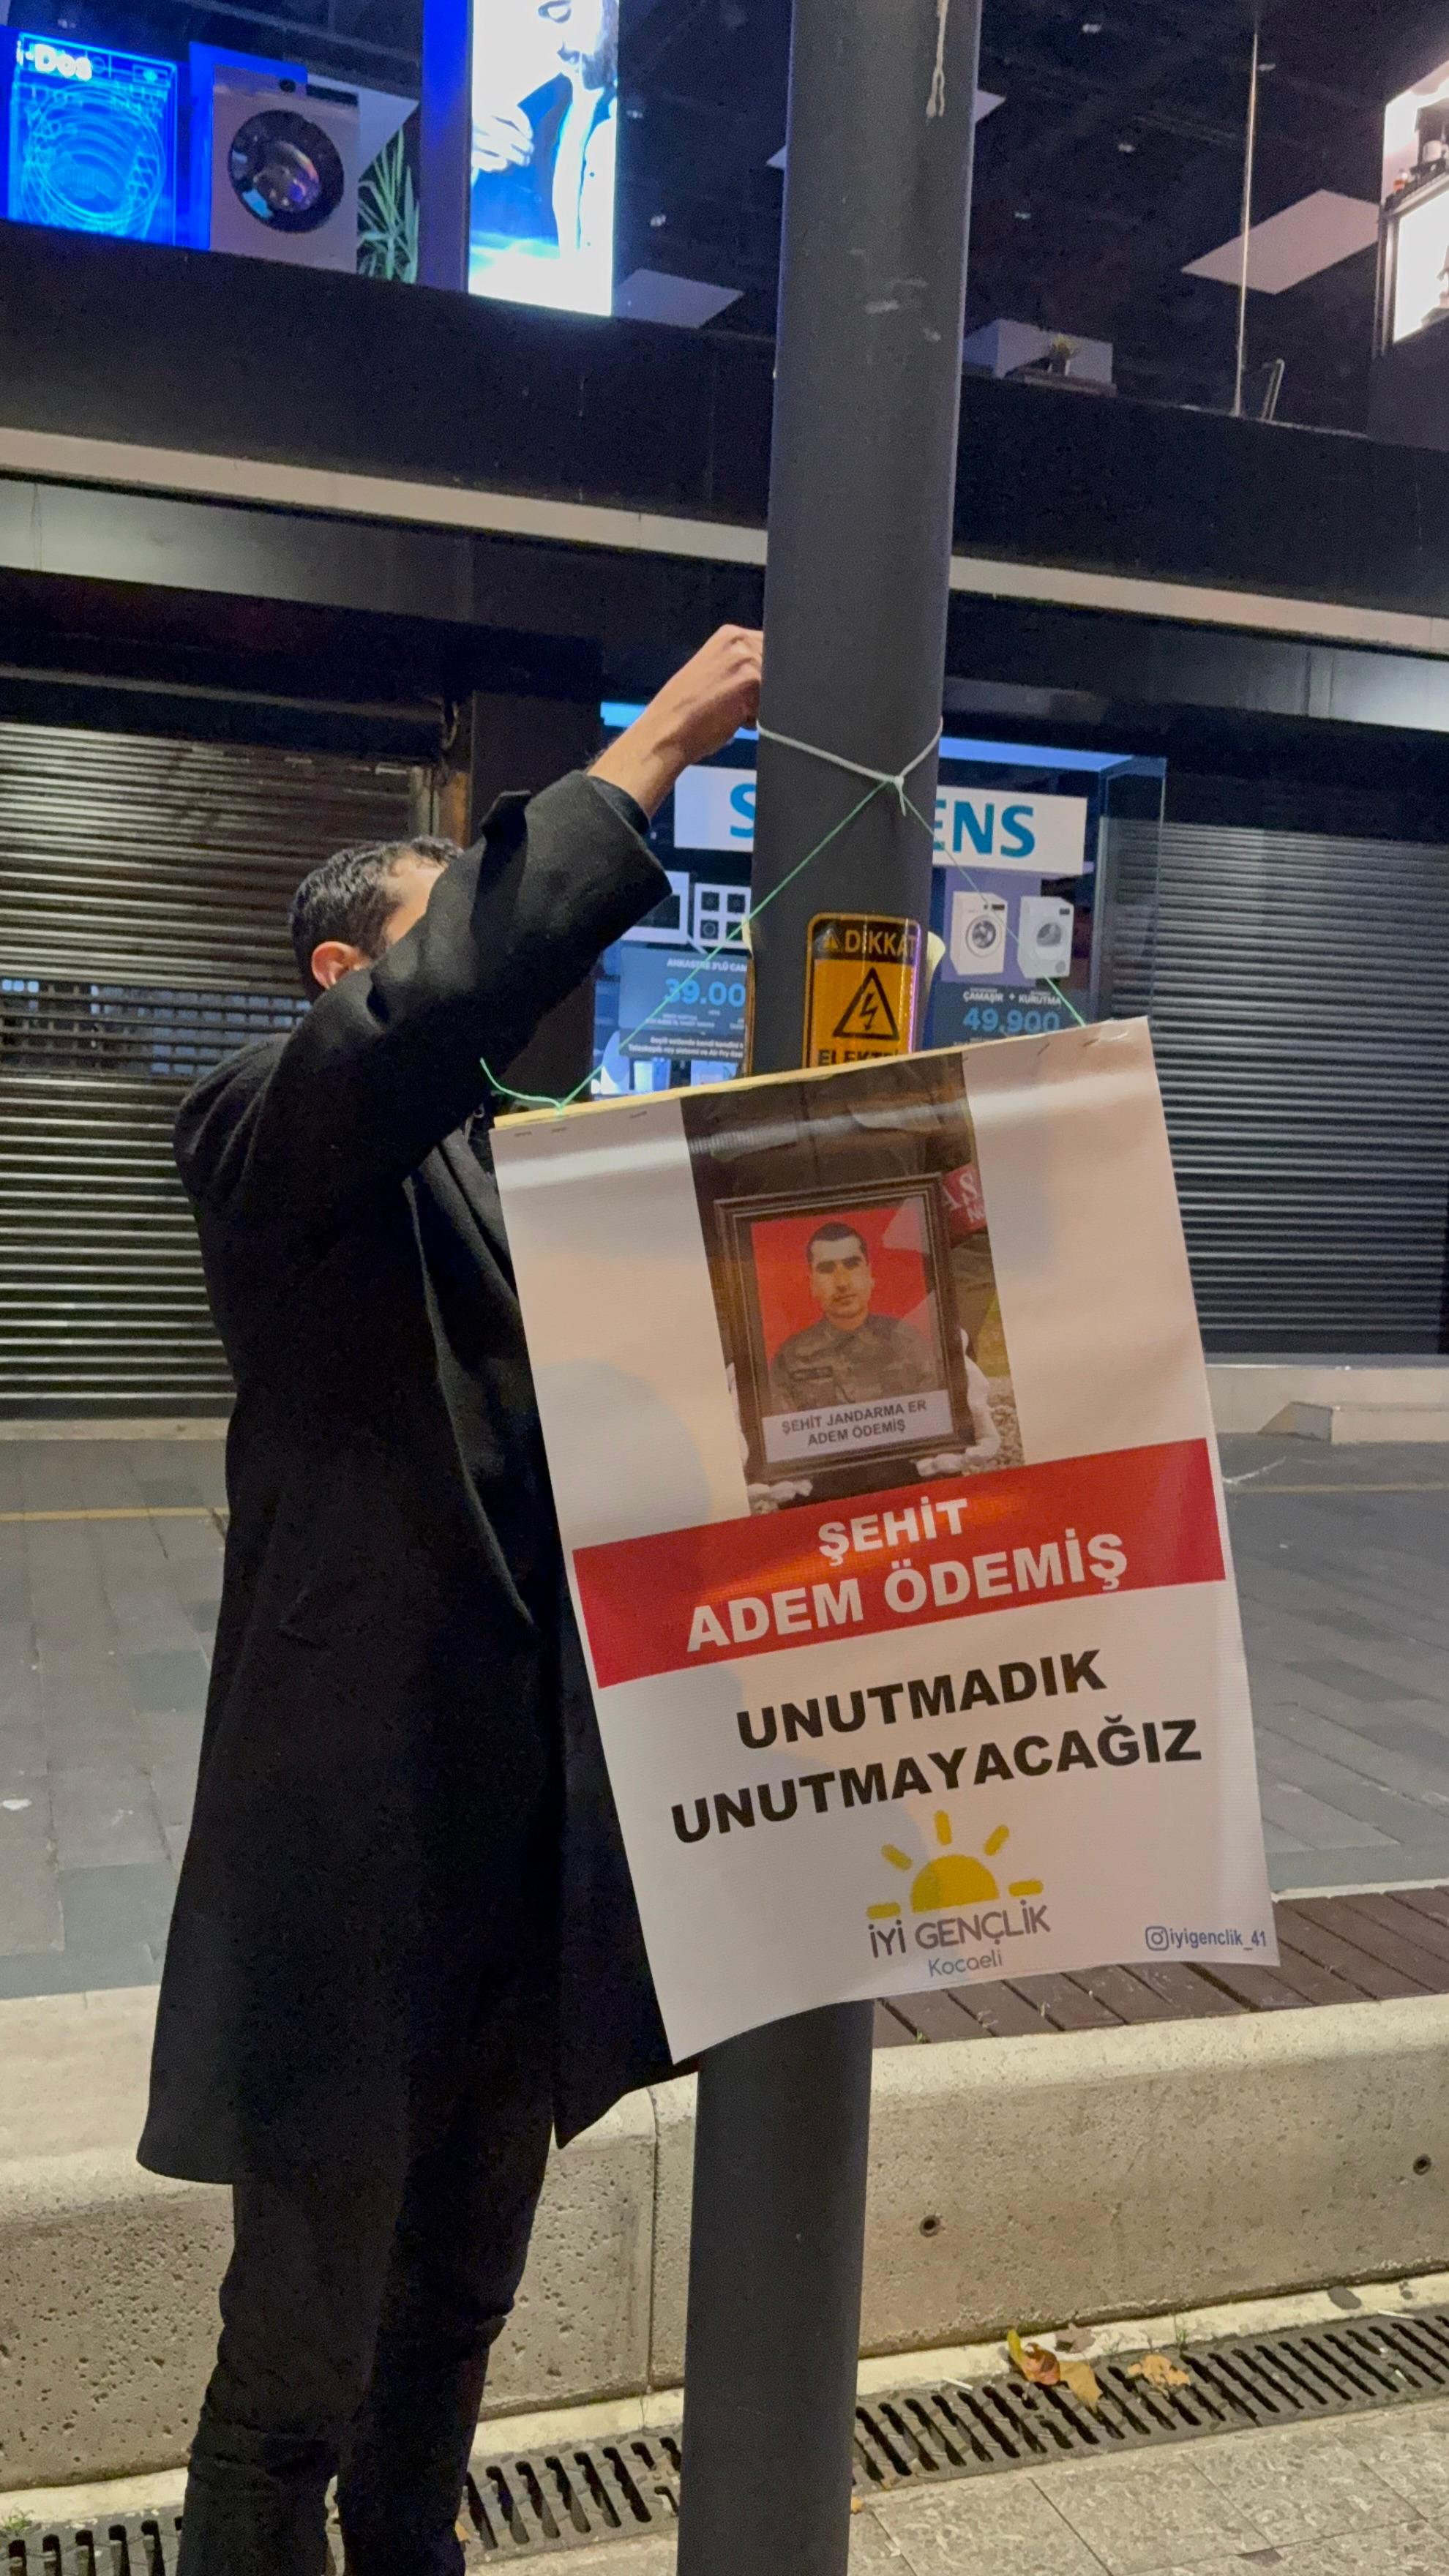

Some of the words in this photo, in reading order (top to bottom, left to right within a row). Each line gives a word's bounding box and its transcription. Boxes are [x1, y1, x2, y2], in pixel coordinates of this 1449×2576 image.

[782, 1415, 822, 1436] ŞEHİT
[827, 1403, 905, 1426] JANDARMA
[908, 1399, 927, 1413] ER
[807, 1430, 849, 1446] ADEM
[853, 1418, 907, 1439] ÖDEMİŞ
[817, 1495, 969, 1566] ŞEHİT
[686, 1581, 864, 1653] ADEM
[884, 1527, 1128, 1613] ÖDEMİŞ
[736, 1649, 1107, 1750] UNUTMADIK
[671, 1715, 1202, 1843] UNUTMAYACAĞIZ
[868, 1920, 907, 1958] İYİ
[915, 1900, 1051, 1950] GENÇLİK
[1170, 1927, 1267, 1952] iyigenclik_41
[928, 1949, 1003, 1977] Kocaeli
